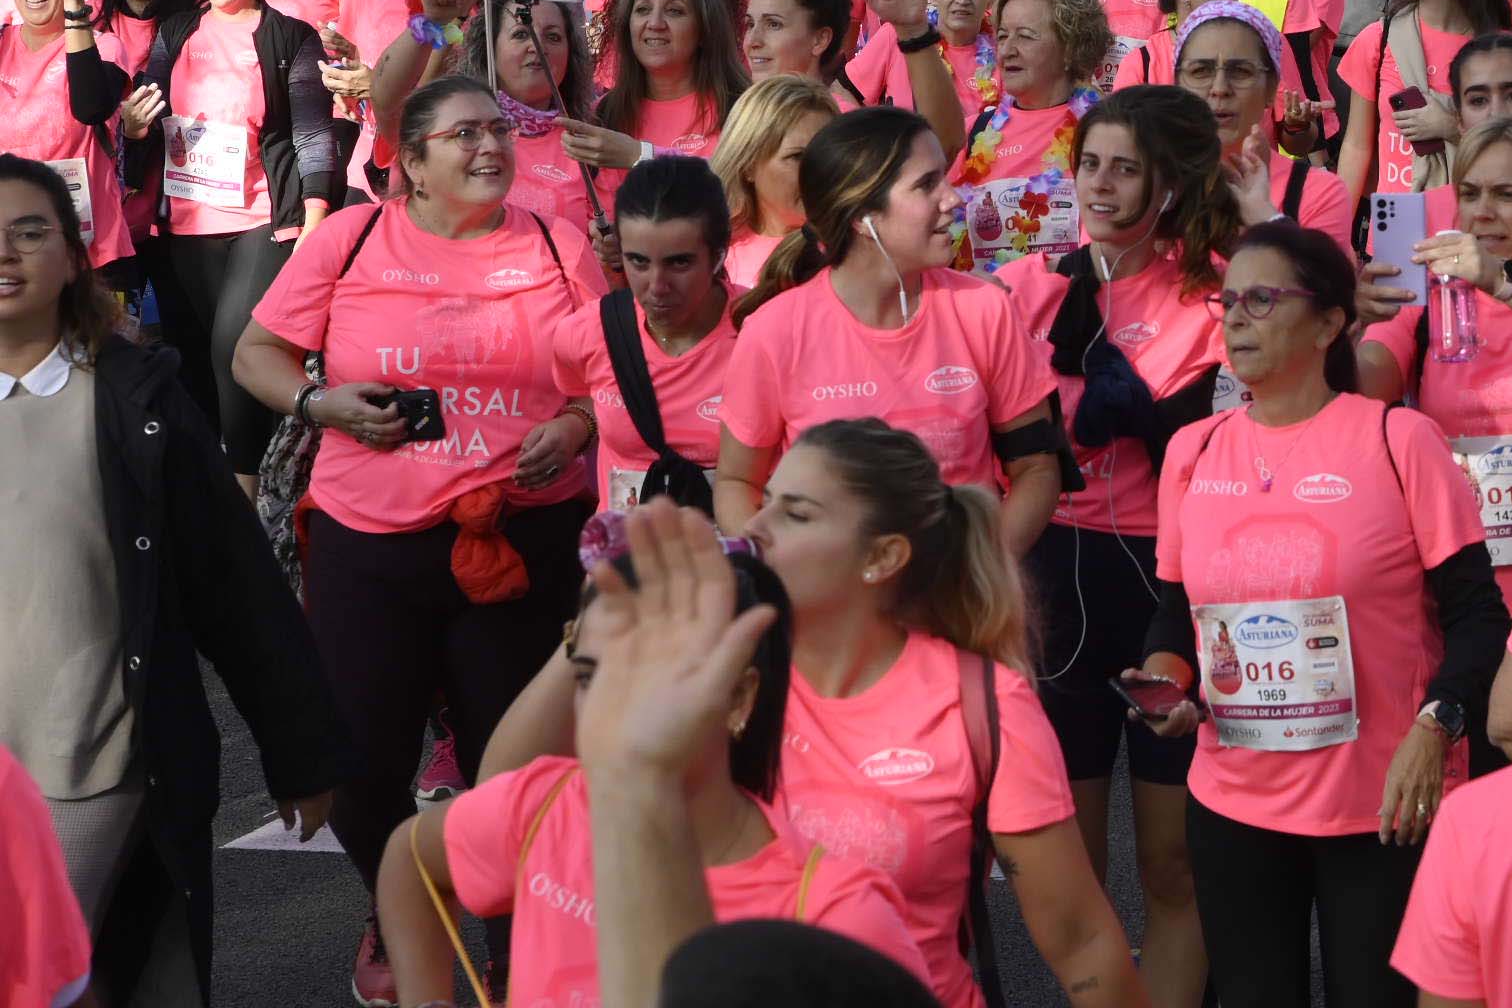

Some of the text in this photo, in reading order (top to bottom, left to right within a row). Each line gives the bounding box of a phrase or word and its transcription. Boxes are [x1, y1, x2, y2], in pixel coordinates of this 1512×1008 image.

[1105, 63, 1120, 73] 01
[995, 144, 1023, 159] SHO
[1387, 163, 1414, 187] DO
[1026, 233, 1038, 243] 41
[382, 269, 440, 285] OYSHO
[376, 347, 421, 376] TU
[596, 388, 625, 408] OYS
[812, 380, 877, 401] OYSHO
[442, 386, 524, 418] RSAL
[1191, 479, 1248, 497] OYSHO
[1487, 529, 1499, 537] RA
[1499, 528, 1512, 536] DE
[1239, 628, 1294, 642] ASTURIANA
[1245, 660, 1296, 682] 016
[1257, 689, 1287, 702] 1969
[1223, 708, 1258, 717] CARRERA
[1258, 708, 1271, 717] DE
[1271, 707, 1283, 716] LA
[1283, 706, 1315, 716] MUJER
[1295, 723, 1345, 737] Santander
